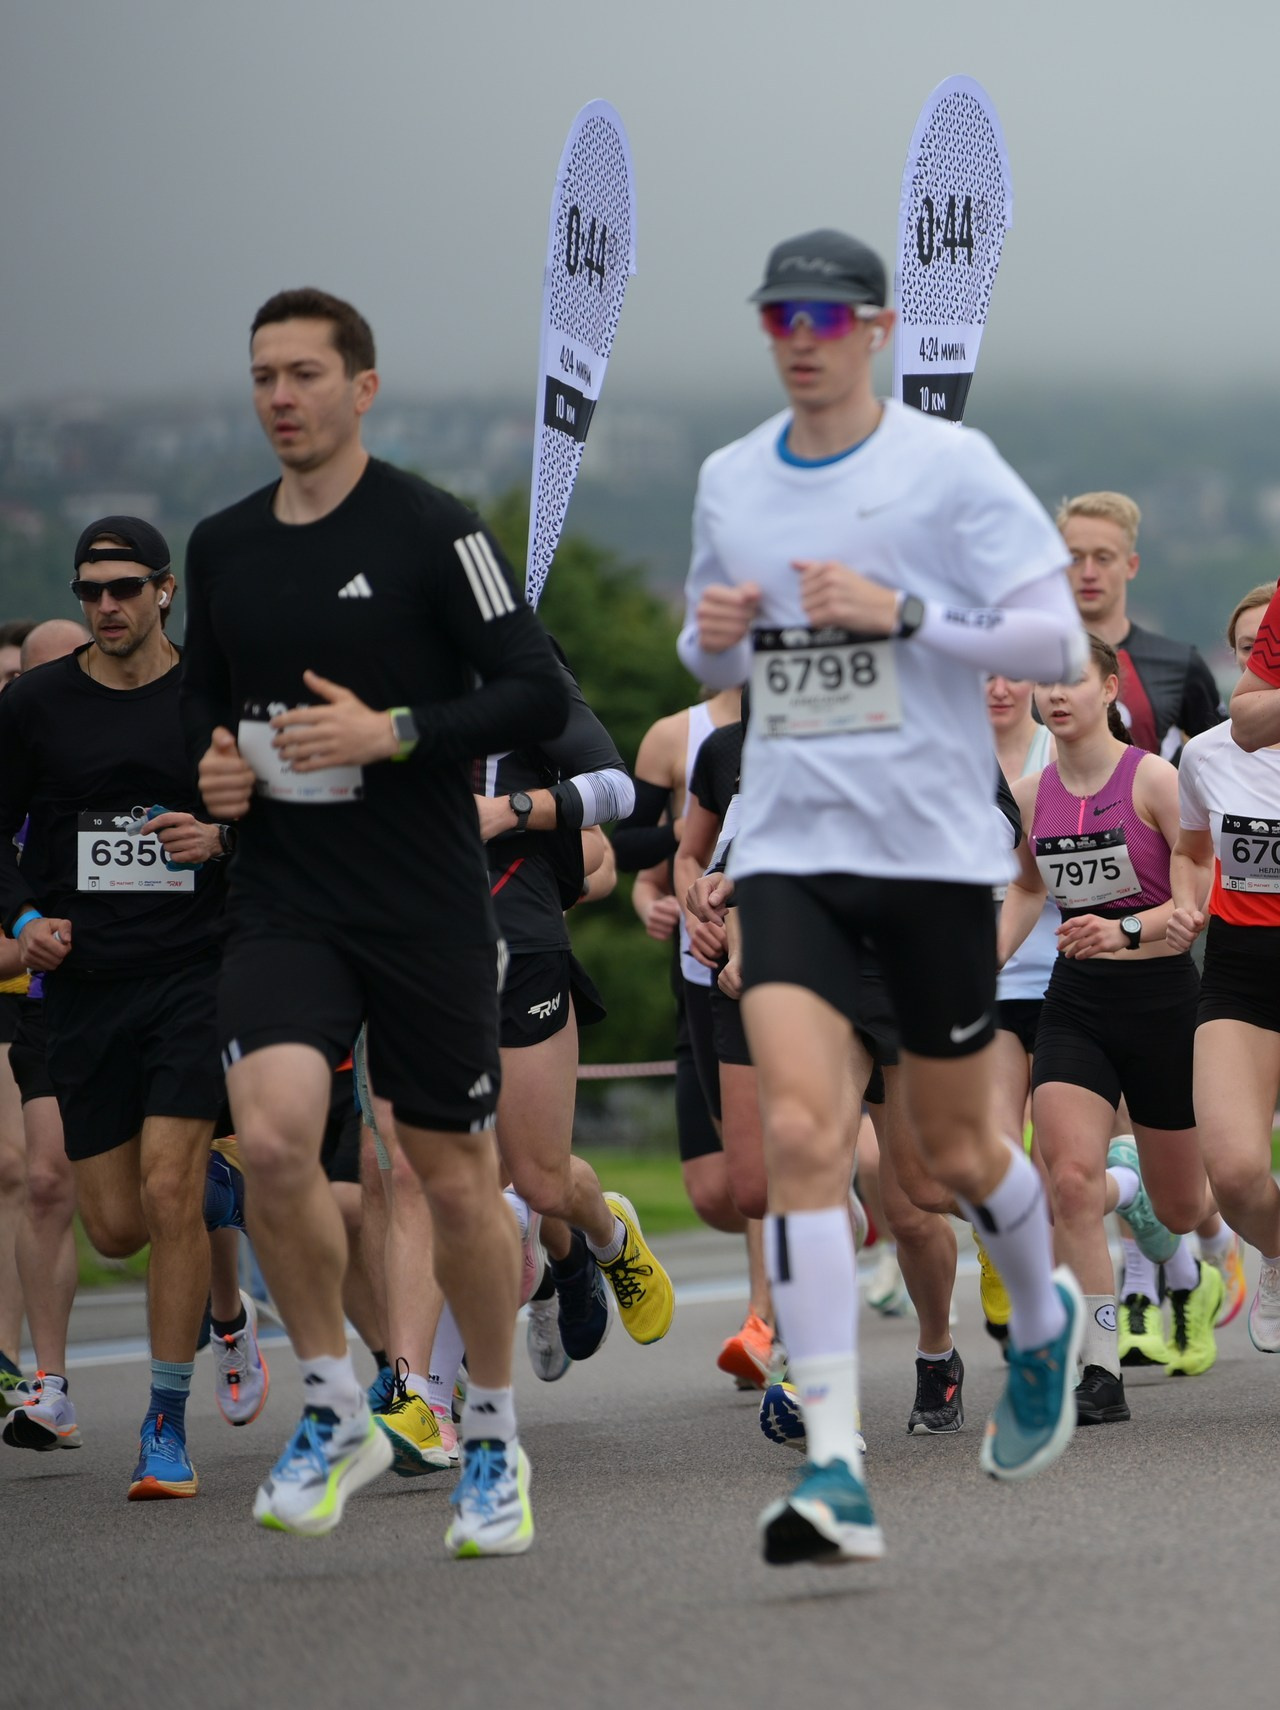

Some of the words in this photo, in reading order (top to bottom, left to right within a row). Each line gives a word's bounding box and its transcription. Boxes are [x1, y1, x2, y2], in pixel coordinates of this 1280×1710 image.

[916, 194, 974, 266] 0:44
[565, 204, 607, 294] 0:44
[919, 336, 939, 362] 4:24
[556, 393, 565, 419] 10
[919, 386, 930, 411] 10
[766, 647, 879, 695] 6798
[1049, 856, 1121, 888] 7975
[1231, 881, 1237, 889] B
